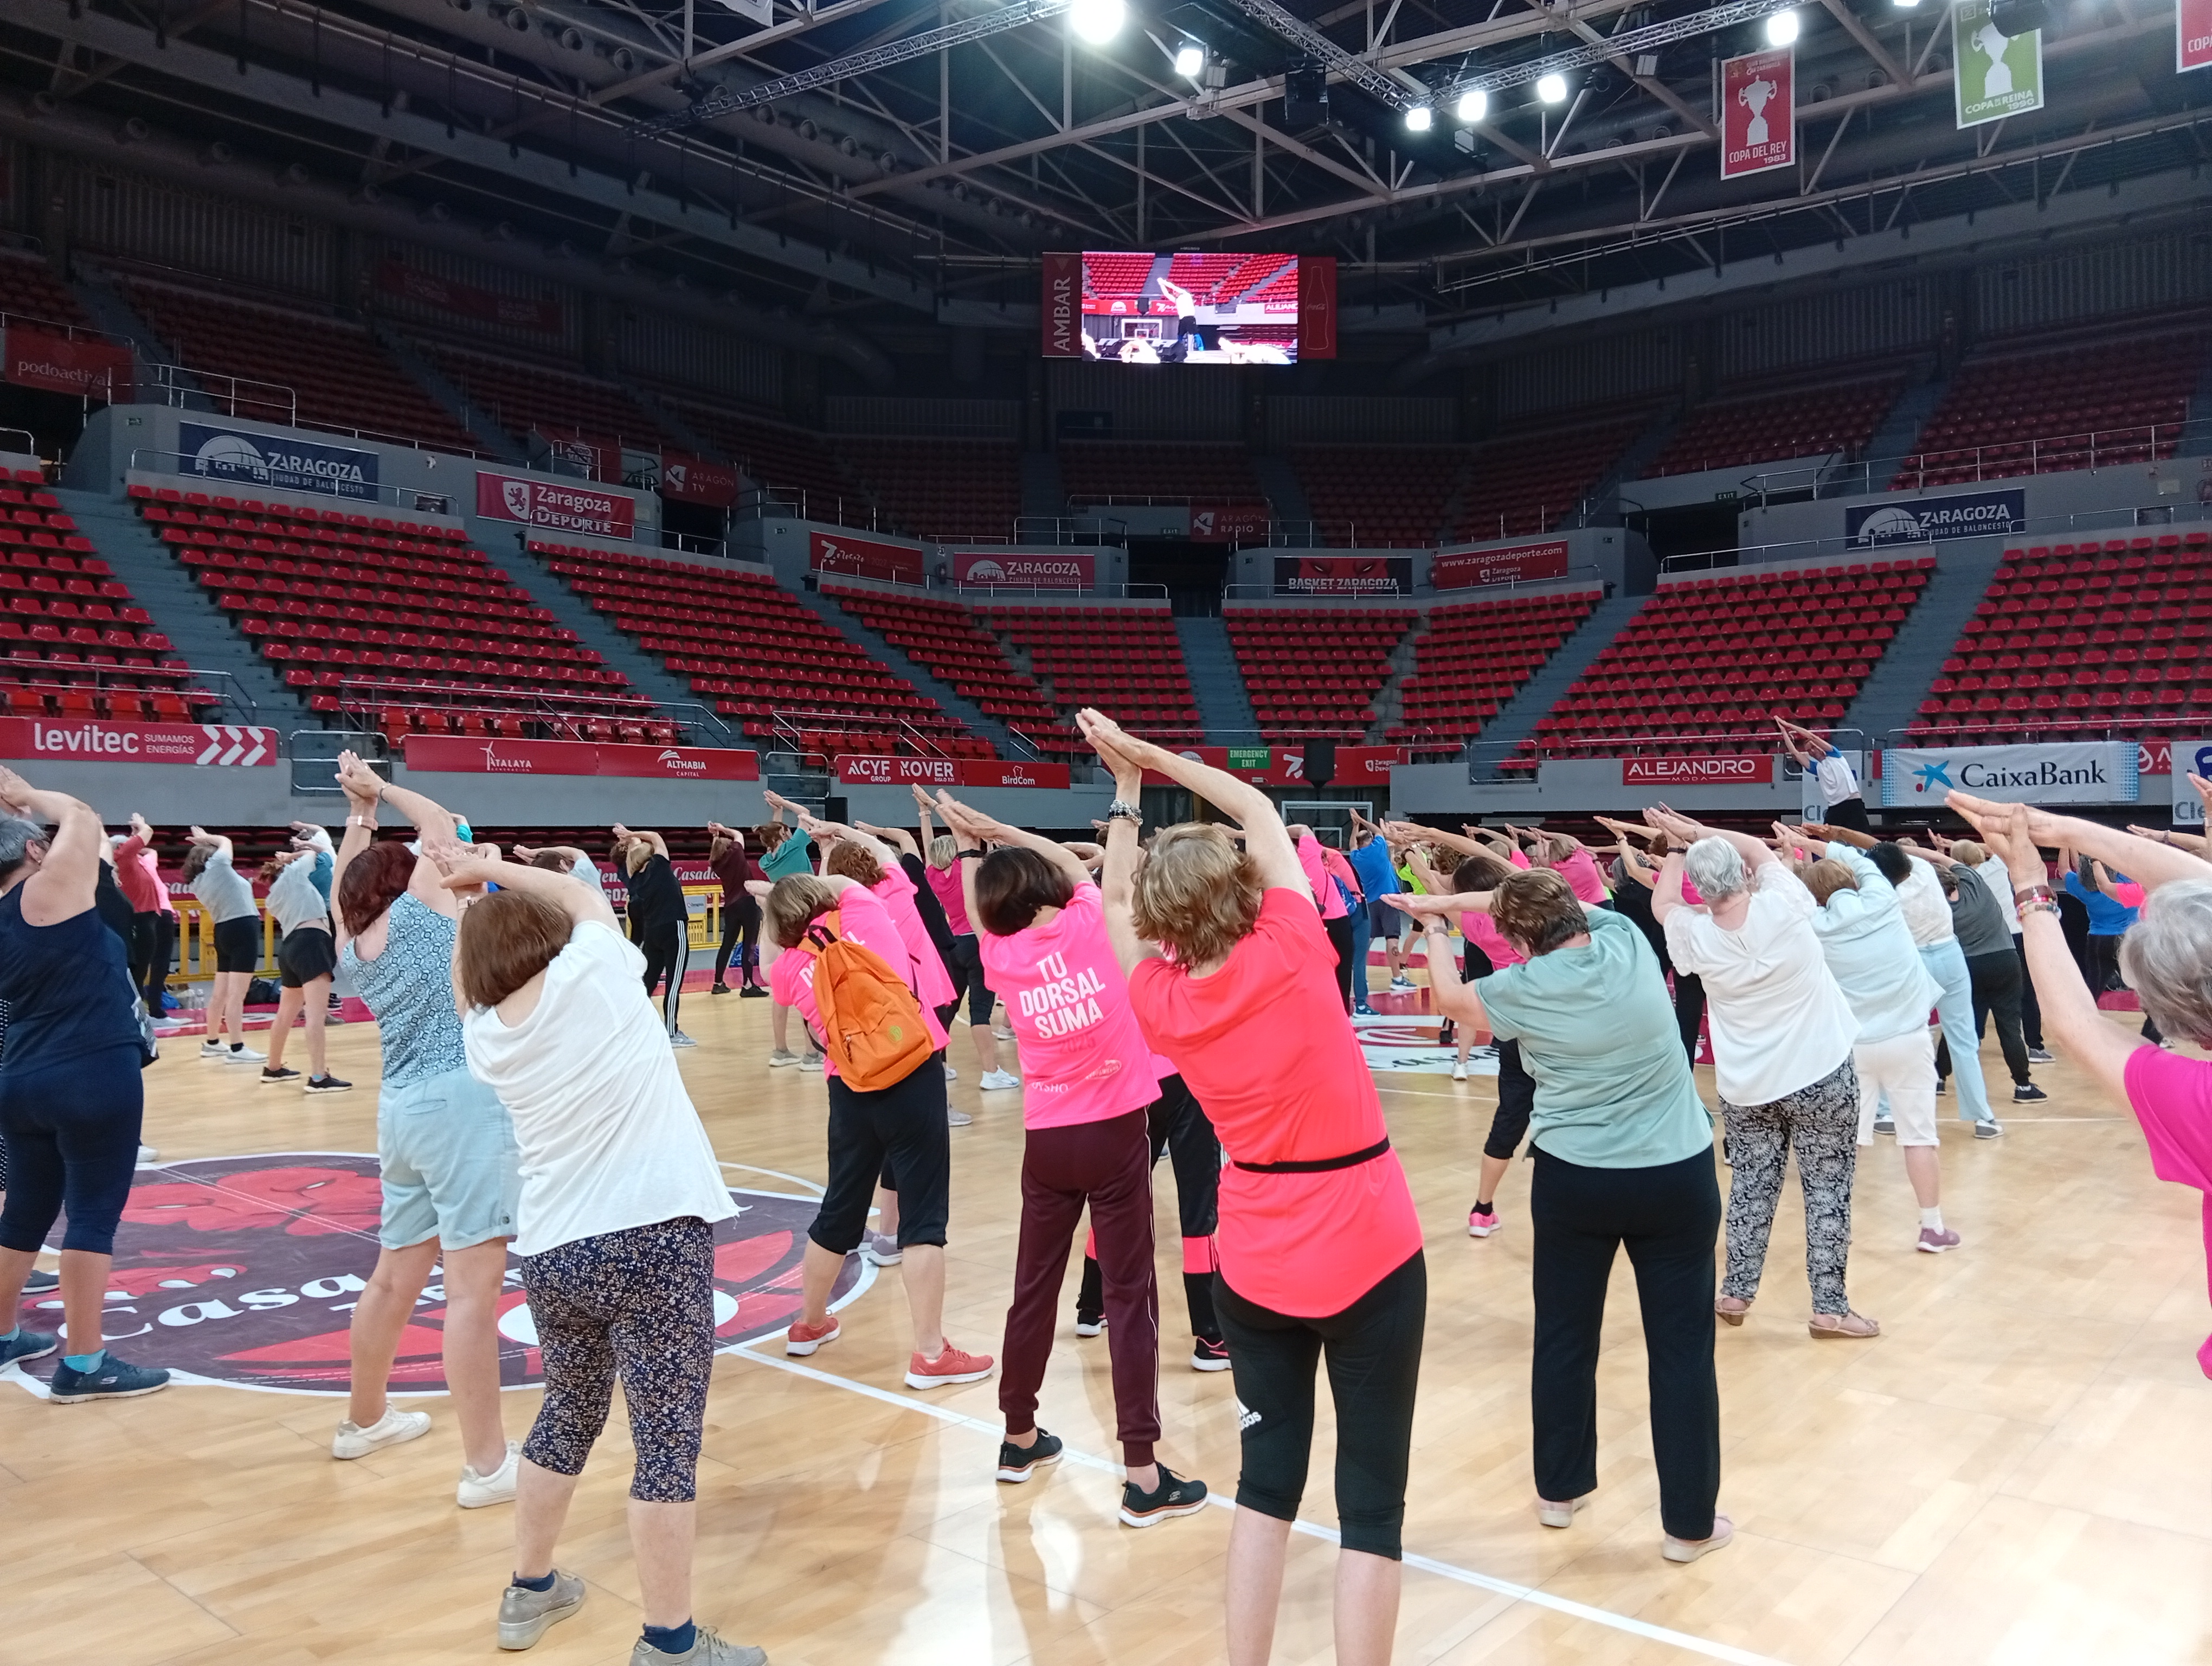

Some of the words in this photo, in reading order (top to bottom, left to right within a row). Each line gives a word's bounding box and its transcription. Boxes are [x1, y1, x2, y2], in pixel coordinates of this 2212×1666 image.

[2188, 35, 2212, 53] COP
[1965, 101, 1994, 114] COPA
[2002, 89, 2034, 105] REINA
[2008, 98, 2034, 110] 1990
[1729, 149, 1751, 163] COPA
[1753, 146, 1768, 158] DEL
[1771, 140, 1787, 155] REY
[1764, 154, 1786, 163] 1983
[1053, 276, 1071, 353] AMBAR
[267, 452, 363, 482] ZARAGOZA
[316, 479, 364, 495] BALOCESTO
[693, 483, 705, 492] TV
[537, 486, 611, 513] Zaragoza
[537, 505, 612, 533] DEPORTE
[1919, 504, 2010, 528] ZARAGOZA
[1221, 525, 1254, 533] RADIO
[1964, 521, 2010, 533] BALONCESTO
[1441, 547, 1562, 567] www.zaragozadeporte.com
[1007, 562, 1082, 576] ZARAGOZA
[1492, 566, 1521, 575] Zaragoza
[1288, 578, 1335, 590] BASKET
[1336, 578, 1398, 590] ZARAGOZA
[35, 723, 139, 754] levitec
[144, 734, 195, 745] SUMAMOS
[145, 743, 195, 755] ENERGÍAS
[1230, 750, 1268, 758] EMERGENCY
[488, 757, 532, 768] ATALAYA
[666, 759, 707, 770] ALTHABIA
[847, 760, 890, 776] ACYF
[1242, 759, 1256, 768] EXIT
[1628, 759, 1756, 776] ALEJANDRO
[1002, 776, 1036, 785] BirdCom
[1960, 759, 2107, 789] CaixaBank
[1036, 951, 1068, 983] TU
[1019, 967, 1106, 1017] DORSAL
[1034, 997, 1104, 1039] SUMA
[57, 1272, 367, 1341] Casa
